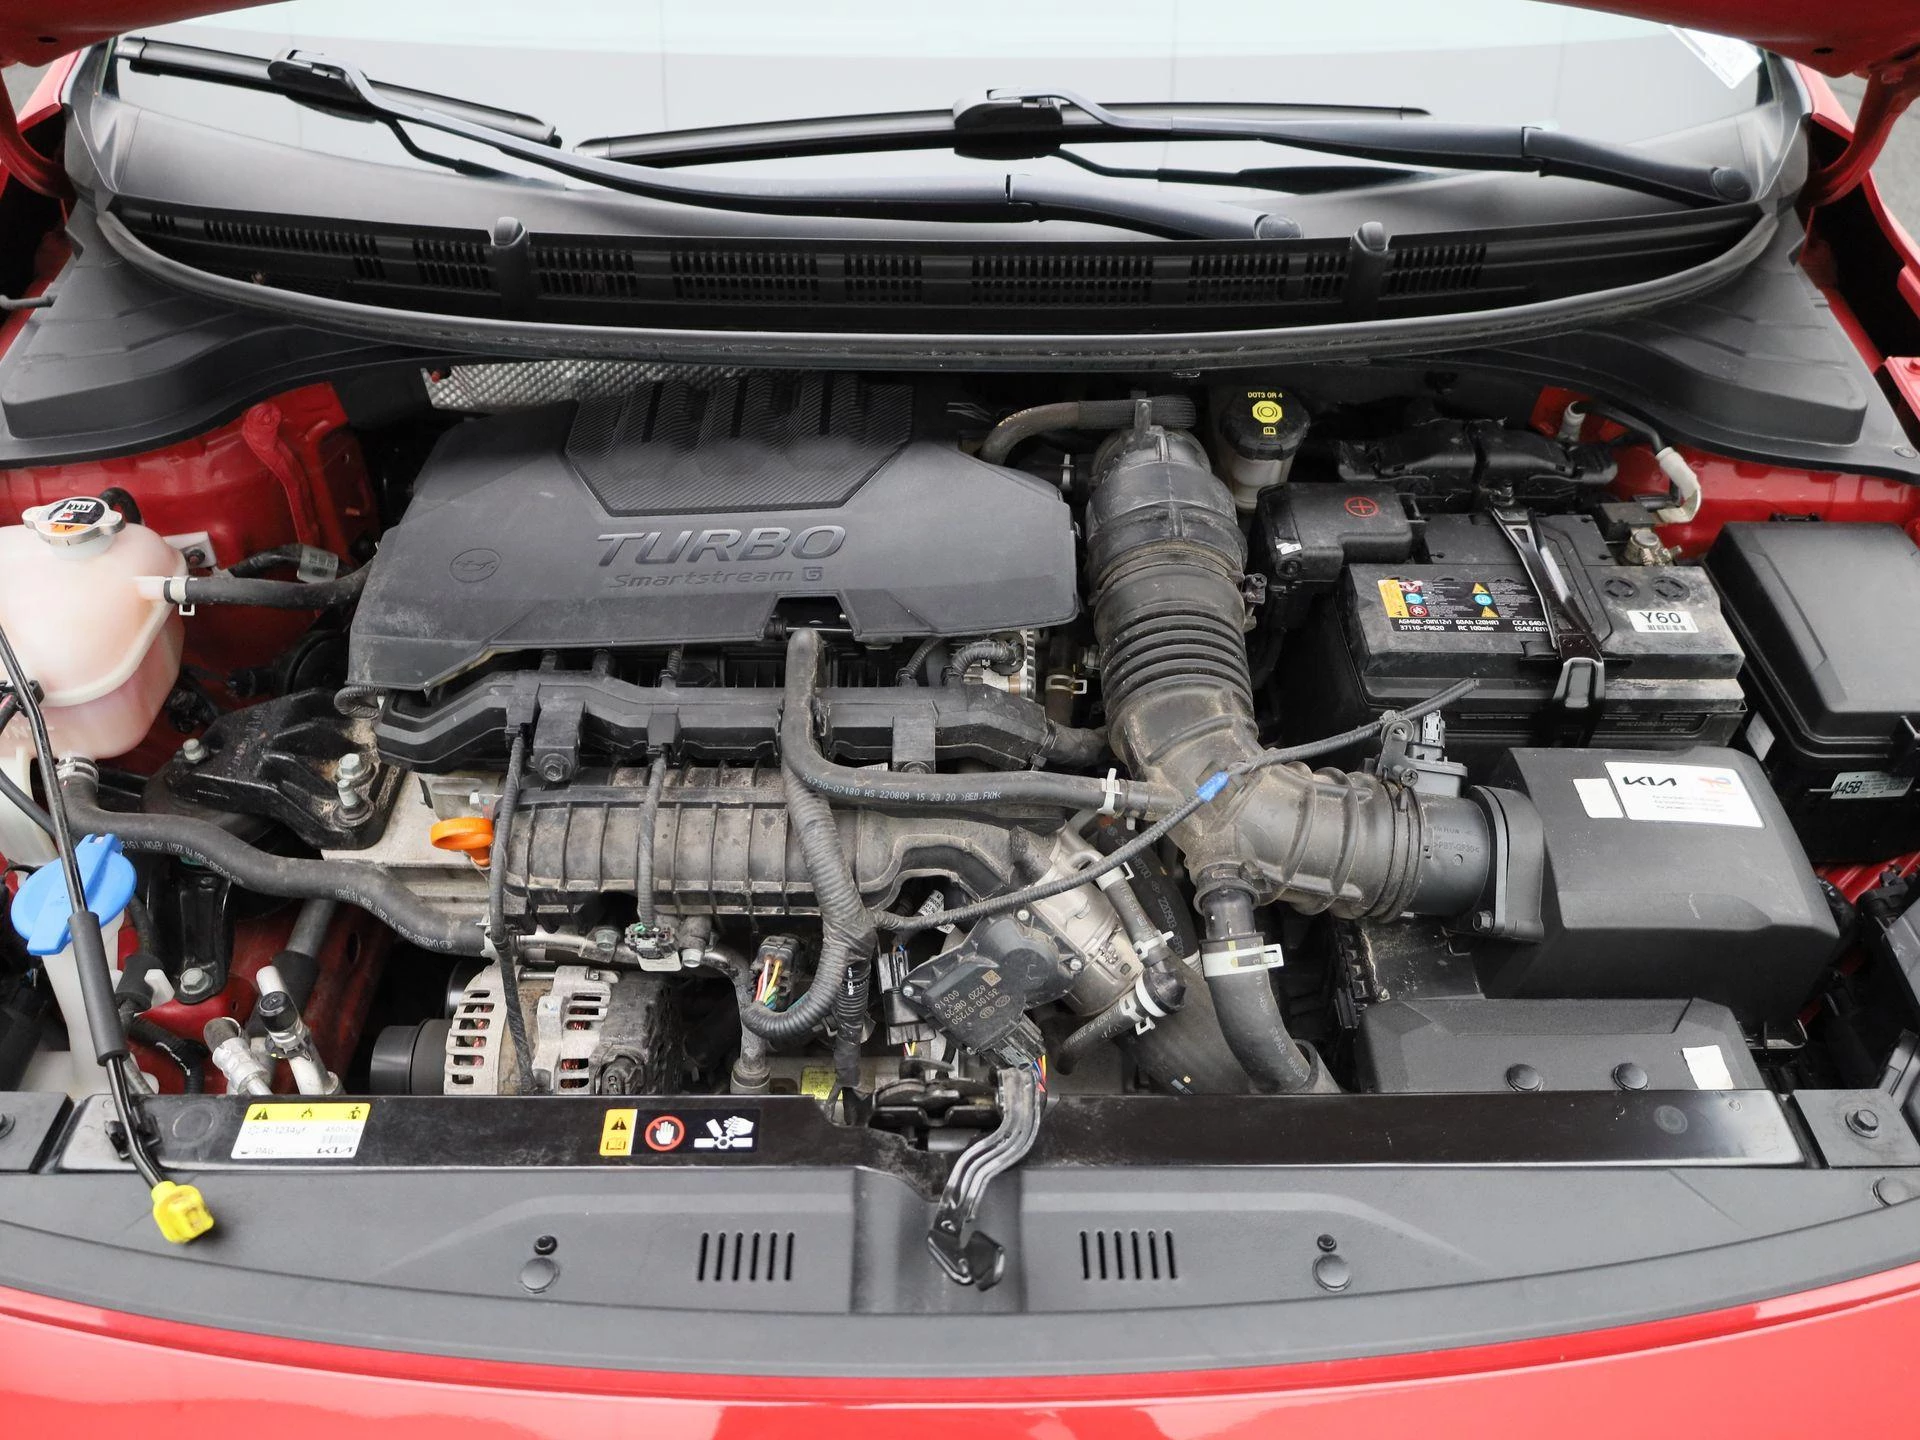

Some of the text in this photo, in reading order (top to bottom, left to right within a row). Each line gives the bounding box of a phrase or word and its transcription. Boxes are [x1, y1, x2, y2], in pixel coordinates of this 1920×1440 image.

[1247, 391, 1266, 399] DOT3
[597, 525, 847, 567] TURBO
[608, 570, 794, 589] Smartstream
[1640, 612, 1682, 624] Y60
[1622, 775, 1678, 787] KIA
